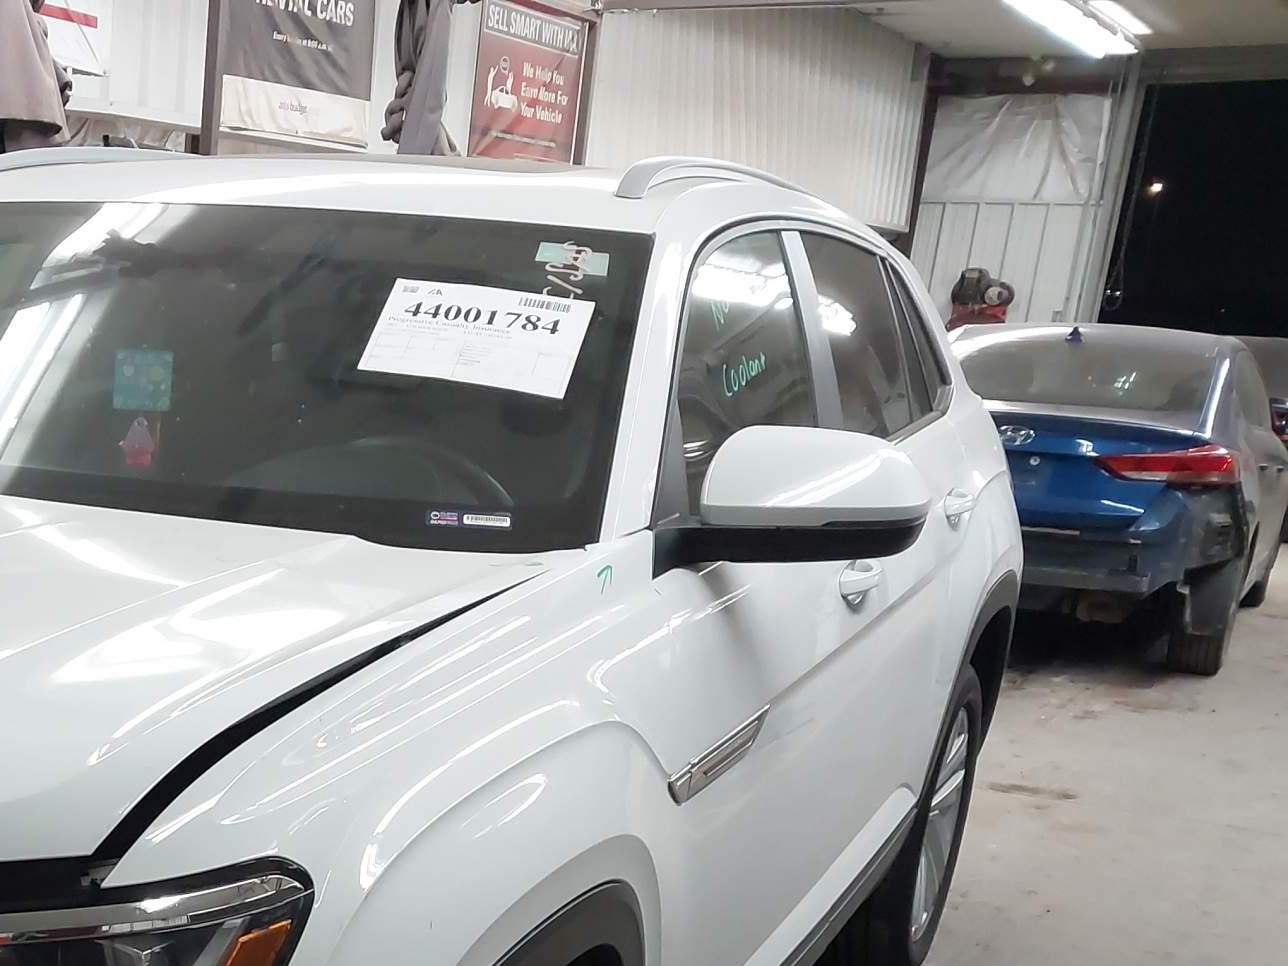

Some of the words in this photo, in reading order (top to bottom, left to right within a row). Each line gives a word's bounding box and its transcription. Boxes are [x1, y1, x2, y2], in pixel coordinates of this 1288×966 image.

[317, 0, 354, 27] CARS
[488, 5, 508, 31] SELL
[510, 12, 541, 41] SMART
[542, 21, 564, 48] WITH
[552, 70, 564, 86] You
[539, 86, 555, 104] More
[556, 90, 569, 106] For
[521, 101, 535, 118] Your
[536, 105, 562, 124] Vehicle
[404, 301, 561, 335] 44001784
